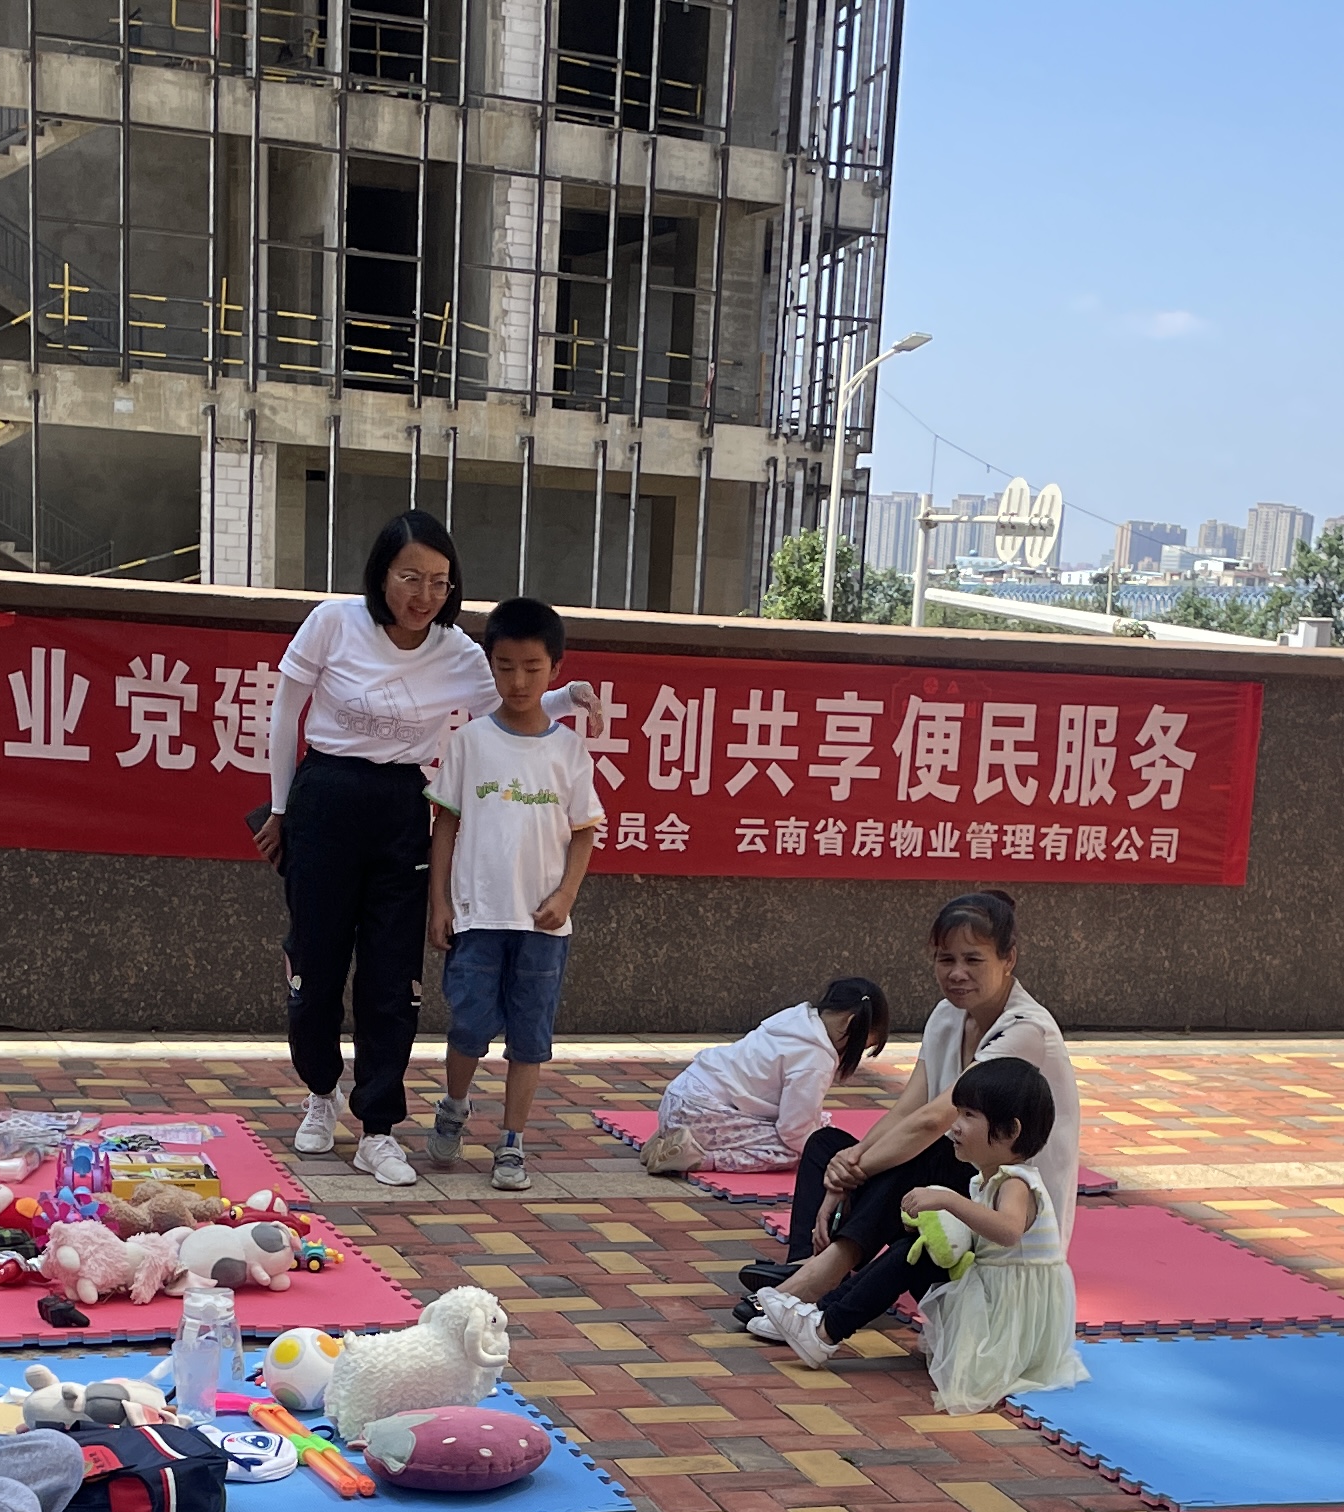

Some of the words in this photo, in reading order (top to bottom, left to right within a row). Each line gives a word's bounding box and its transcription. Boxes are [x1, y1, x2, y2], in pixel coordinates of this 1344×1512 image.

[735, 815, 1180, 864] 云南省房物业管理有限公司
